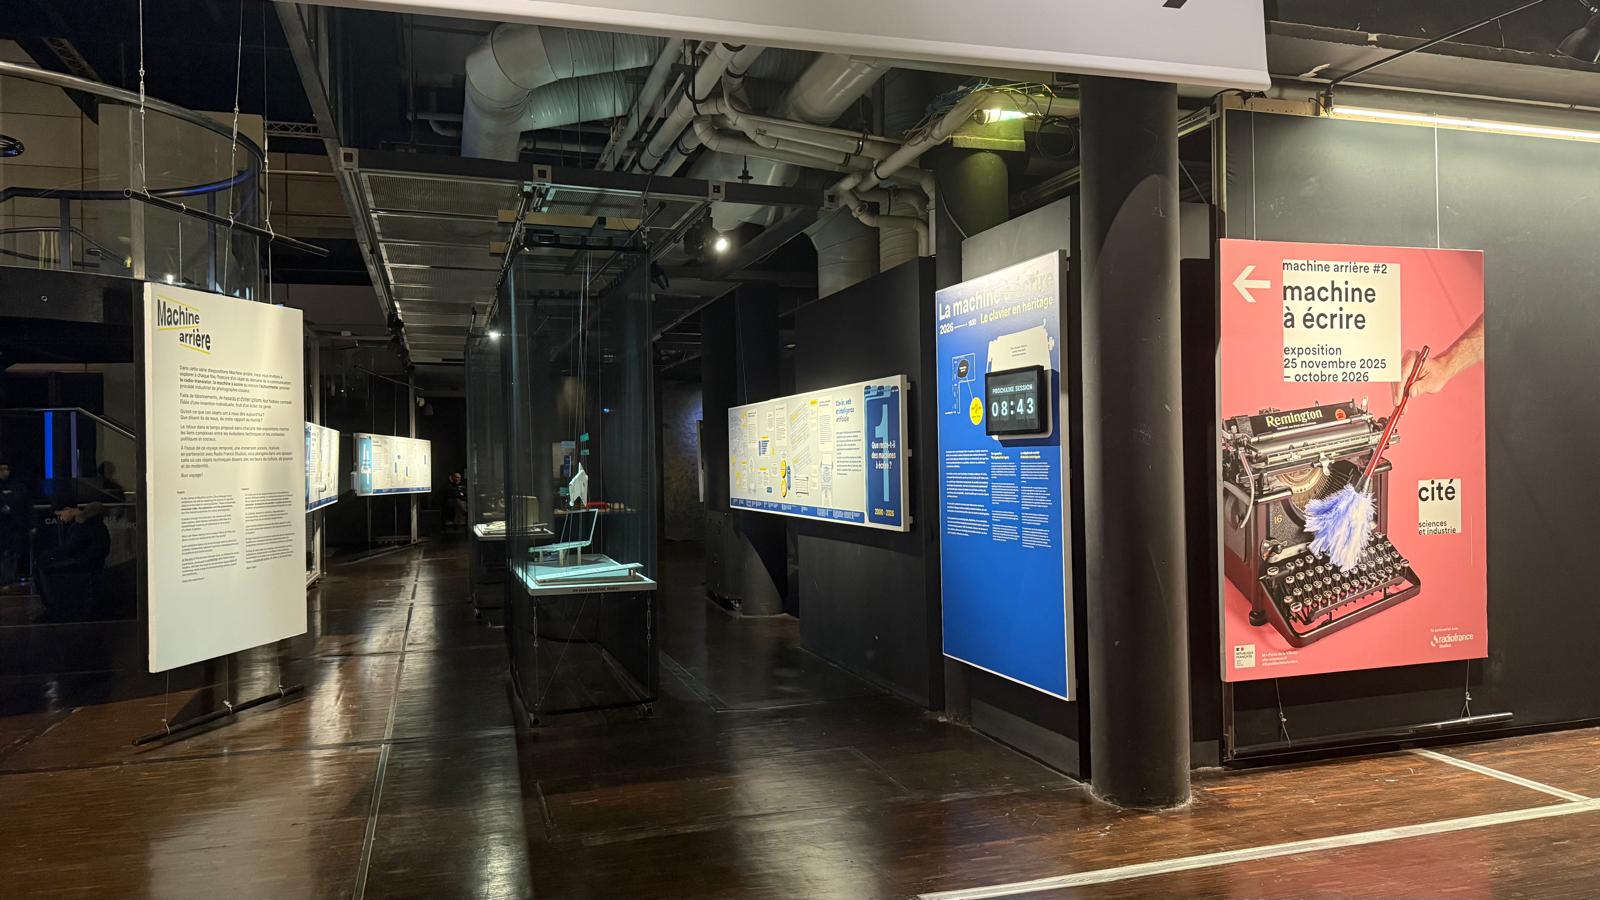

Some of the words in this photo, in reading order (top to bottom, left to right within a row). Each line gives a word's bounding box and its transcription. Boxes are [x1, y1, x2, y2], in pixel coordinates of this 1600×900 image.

[1282, 260, 1330, 272] machine
[1334, 262, 1370, 274] arrière
[1373, 264, 1388, 274] #2
[1283, 280, 1376, 303] machine
[158, 300, 200, 326] Machine
[940, 304, 950, 320] La
[981, 313, 988, 324] Le
[990, 307, 1011, 322] clavier
[1012, 304, 1020, 314] en
[1022, 296, 1054, 312] héritage
[1284, 306, 1294, 328] à
[1302, 306, 1366, 330] écrire
[180, 329, 210, 350] arrière
[1284, 344, 1342, 357] exposition
[1284, 358, 1297, 368] 25
[1301, 358, 1356, 368] novembre
[1360, 359, 1386, 368] 2025
[1294, 372, 1338, 382] octobre
[1342, 372, 1369, 382] 2026
[992, 398, 1034, 416] 08:43
[1265, 409, 1322, 428] Remington
[875, 404, 889, 502] 1
[1419, 478, 1455, 501] cité
[1275, 515, 1282, 524] 16
[1427, 526, 1456, 534] industrie
[1439, 633, 1474, 643] radiofrance
